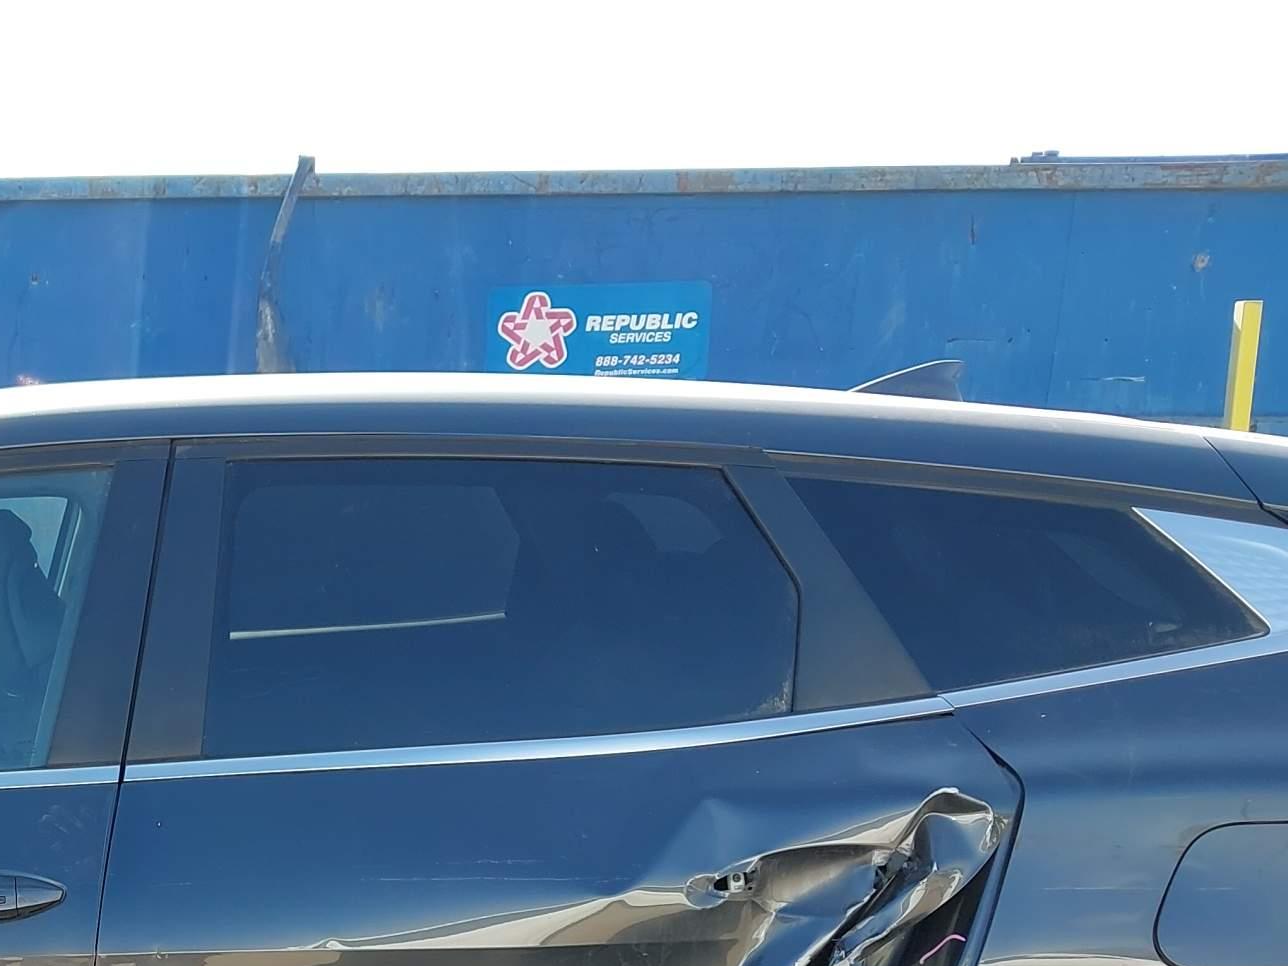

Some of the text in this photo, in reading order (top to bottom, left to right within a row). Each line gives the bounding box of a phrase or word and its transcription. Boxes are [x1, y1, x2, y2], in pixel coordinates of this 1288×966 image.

[585, 311, 698, 332] REPUBLIC
[609, 331, 672, 344] SERVICES
[595, 353, 681, 367] 888-742-5234
